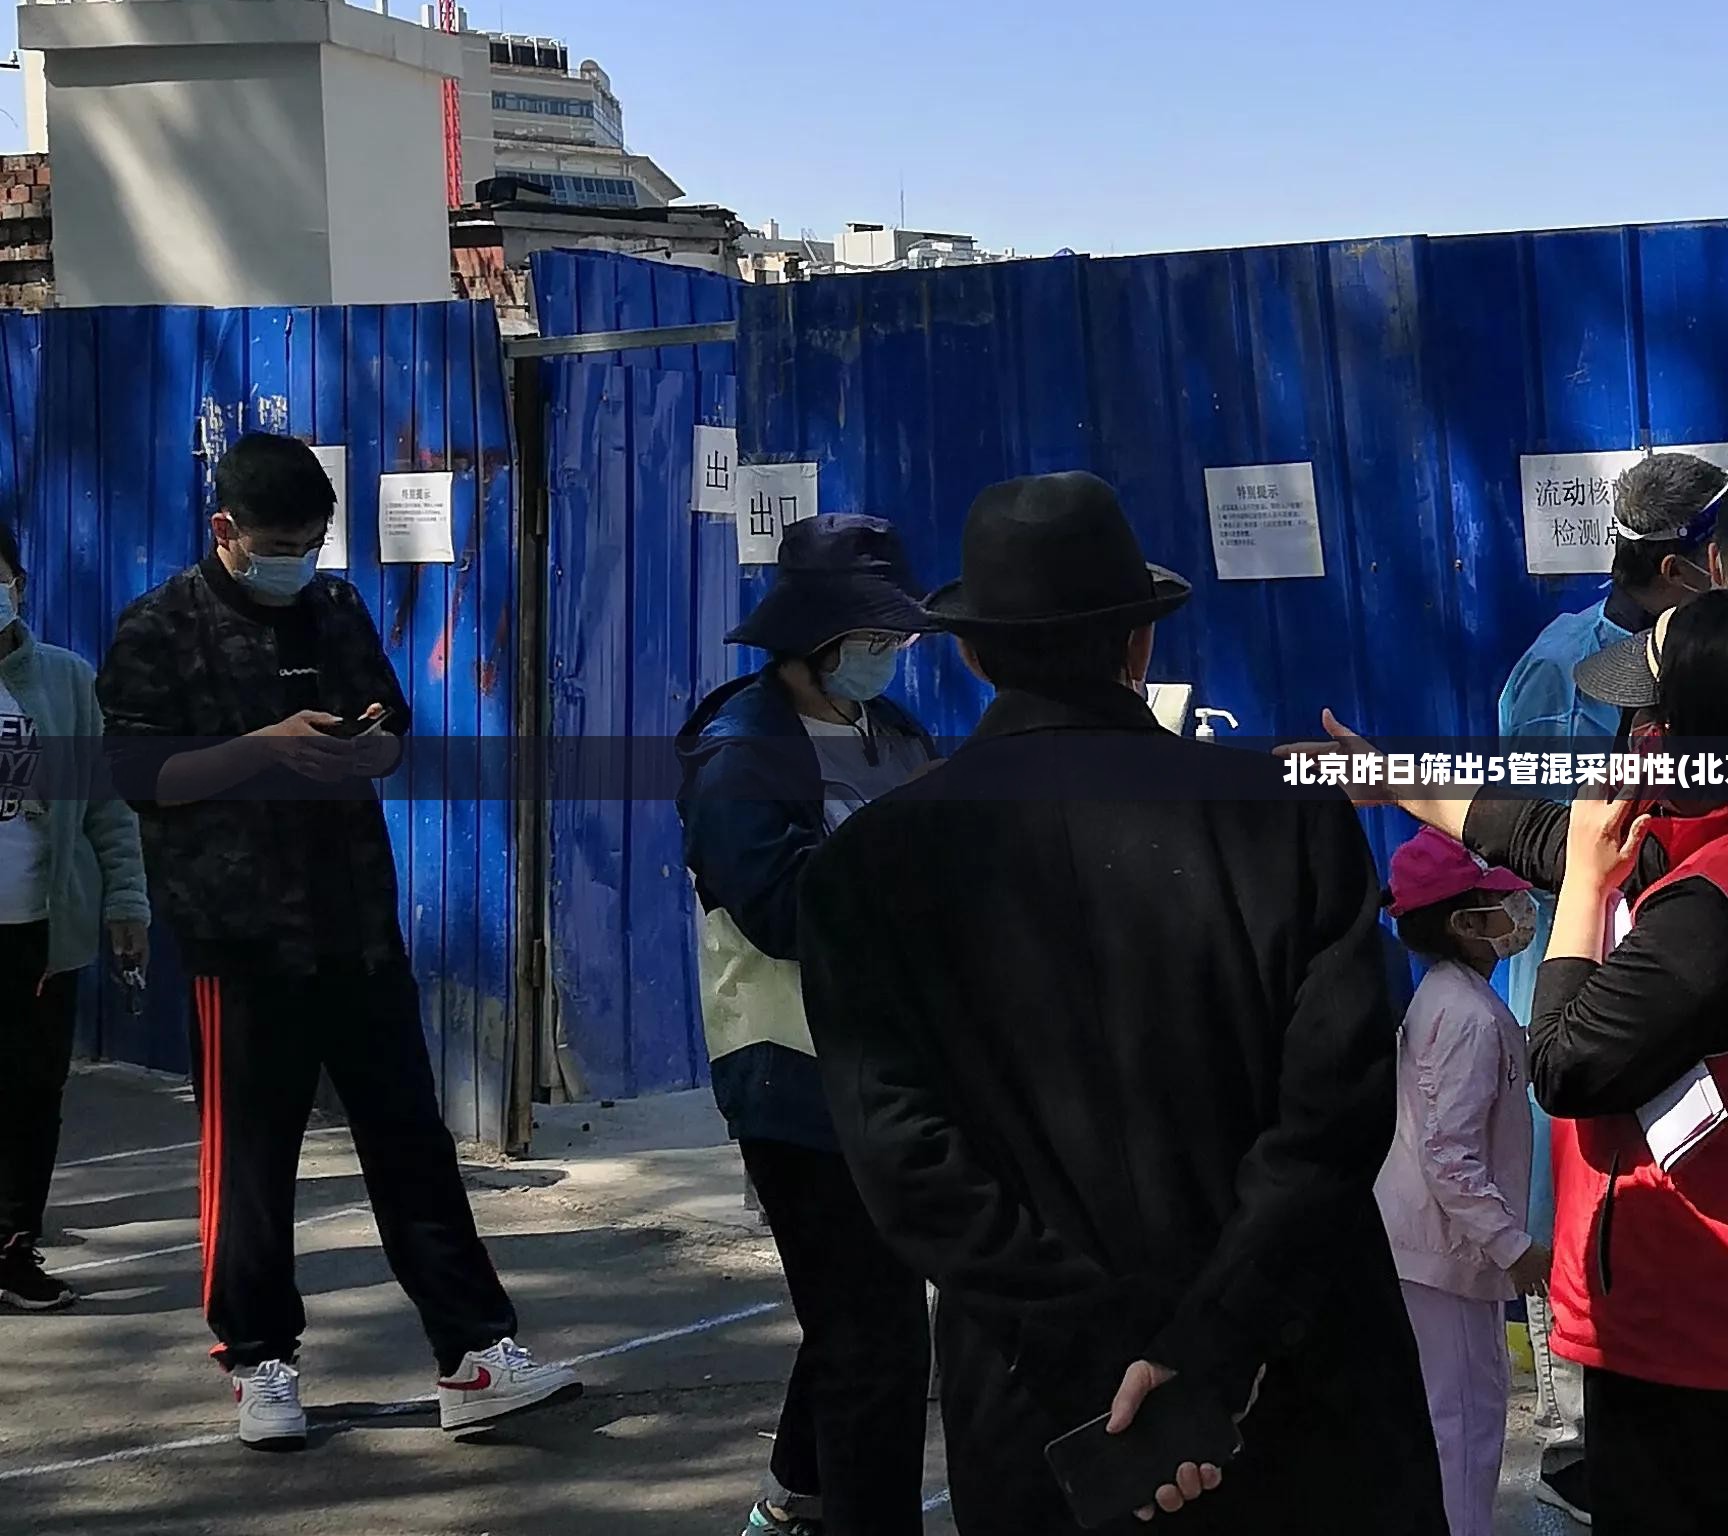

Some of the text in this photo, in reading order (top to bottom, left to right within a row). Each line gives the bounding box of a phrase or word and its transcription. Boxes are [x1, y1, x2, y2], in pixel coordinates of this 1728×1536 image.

[706, 449, 729, 491] 出
[1535, 476, 1618, 507] 流动核
[750, 491, 797, 537] 出口
